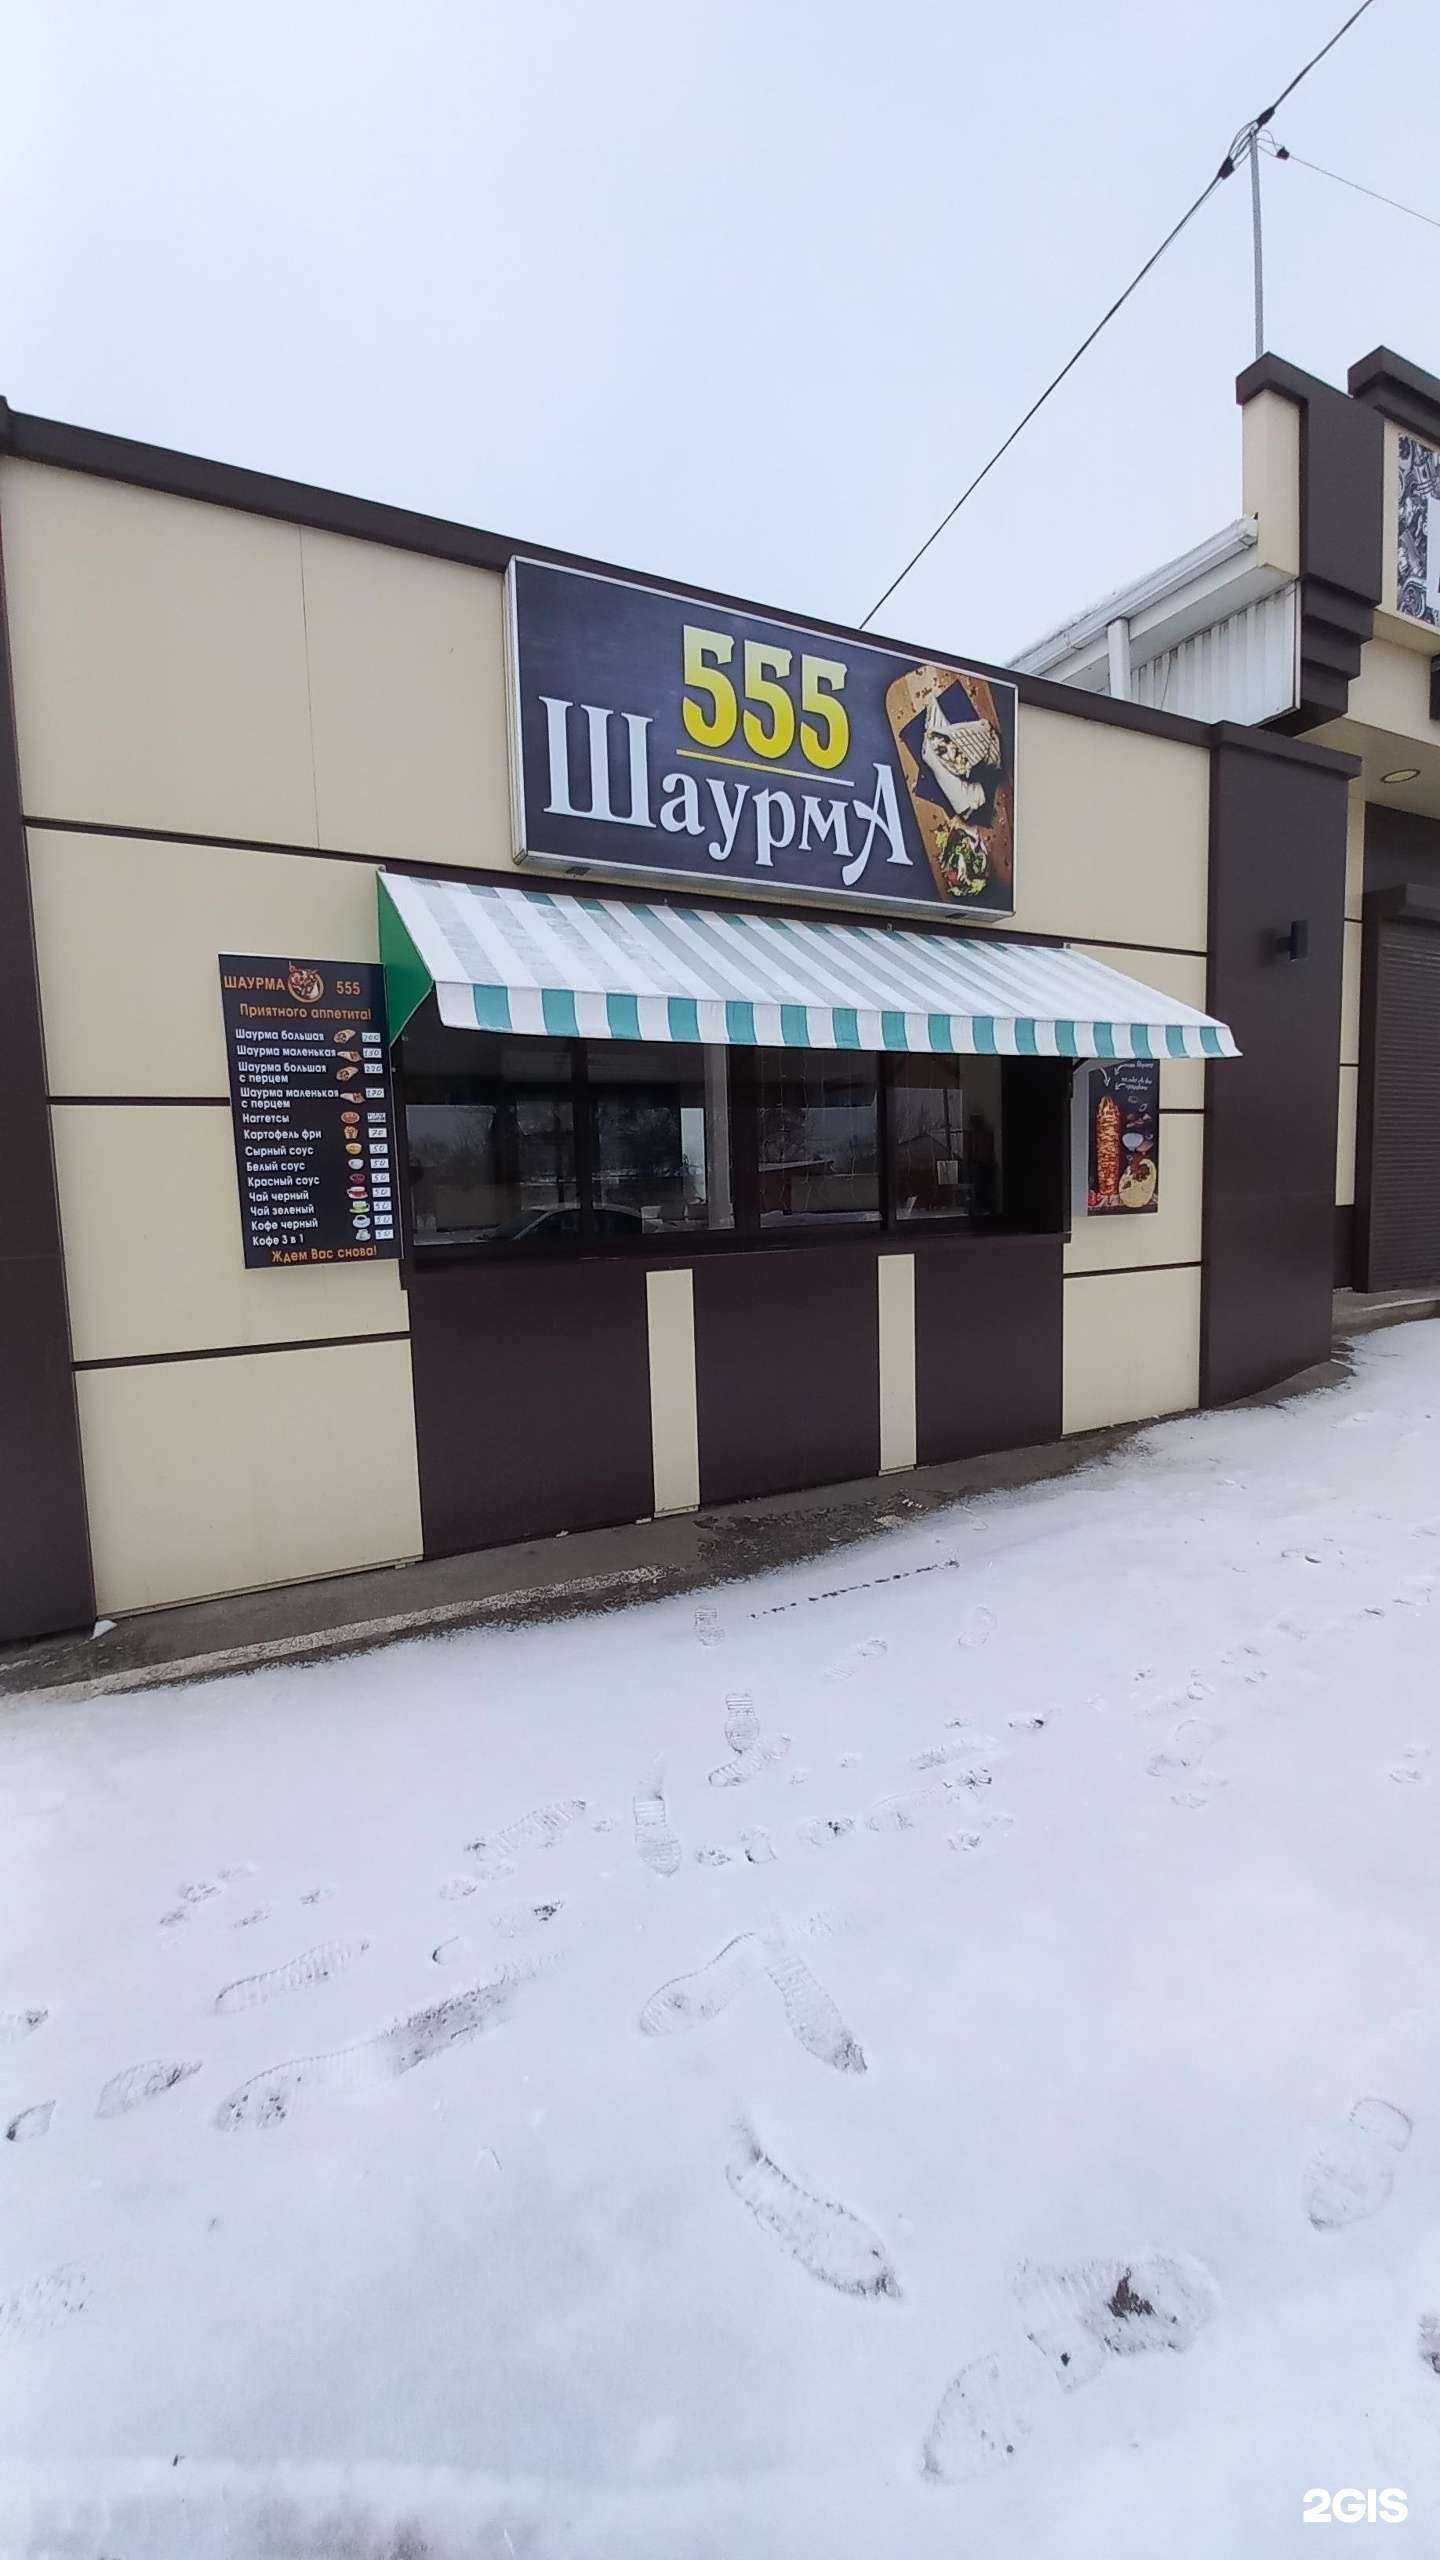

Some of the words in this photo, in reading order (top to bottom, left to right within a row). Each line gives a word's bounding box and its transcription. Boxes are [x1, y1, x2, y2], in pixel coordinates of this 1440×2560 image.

[682, 624, 851, 770] 555
[224, 975, 286, 991] ШАУРМА
[336, 981, 361, 995] 555
[239, 1003, 308, 1018] Приятного
[311, 1008, 372, 1021] аппетита!
[235, 1029, 279, 1042] Шаурма
[281, 1030, 325, 1041] большая
[237, 1046, 280, 1058] Шаурма
[283, 1048, 336, 1057] маленькая
[238, 1062, 281, 1074] Шаурма
[284, 1062, 327, 1073] большая
[249, 1075, 289, 1084] перцем
[240, 1088, 284, 1100] Шаурма
[286, 1089, 339, 1098] маленькая
[241, 1100, 248, 1108] с
[251, 1100, 291, 1109] перцем
[242, 1113, 290, 1123] Наггетсы
[244, 1129, 300, 1141] Картофель
[301, 1129, 322, 1140] фри
[245, 1146, 287, 1157] Сырный
[289, 1147, 314, 1157] соус
[246, 1161, 279, 1172] Белый
[281, 1162, 306, 1171] соус
[248, 1176, 293, 1188] Красный
[295, 1176, 320, 1186] соус
[249, 1191, 269, 1202] Чай
[271, 1190, 309, 1201] черный
[250, 1206, 270, 1216] Чай
[272, 1204, 315, 1216] зеленый
[251, 1220, 278, 1232] Кофе
[280, 1218, 319, 1229] черный
[252, 1235, 279, 1247] Кофе
[282, 1235, 288, 1245] 3
[272, 1250, 308, 1263] Ждем
[311, 1249, 334, 1260] Вас
[337, 1245, 377, 1258] снова!
